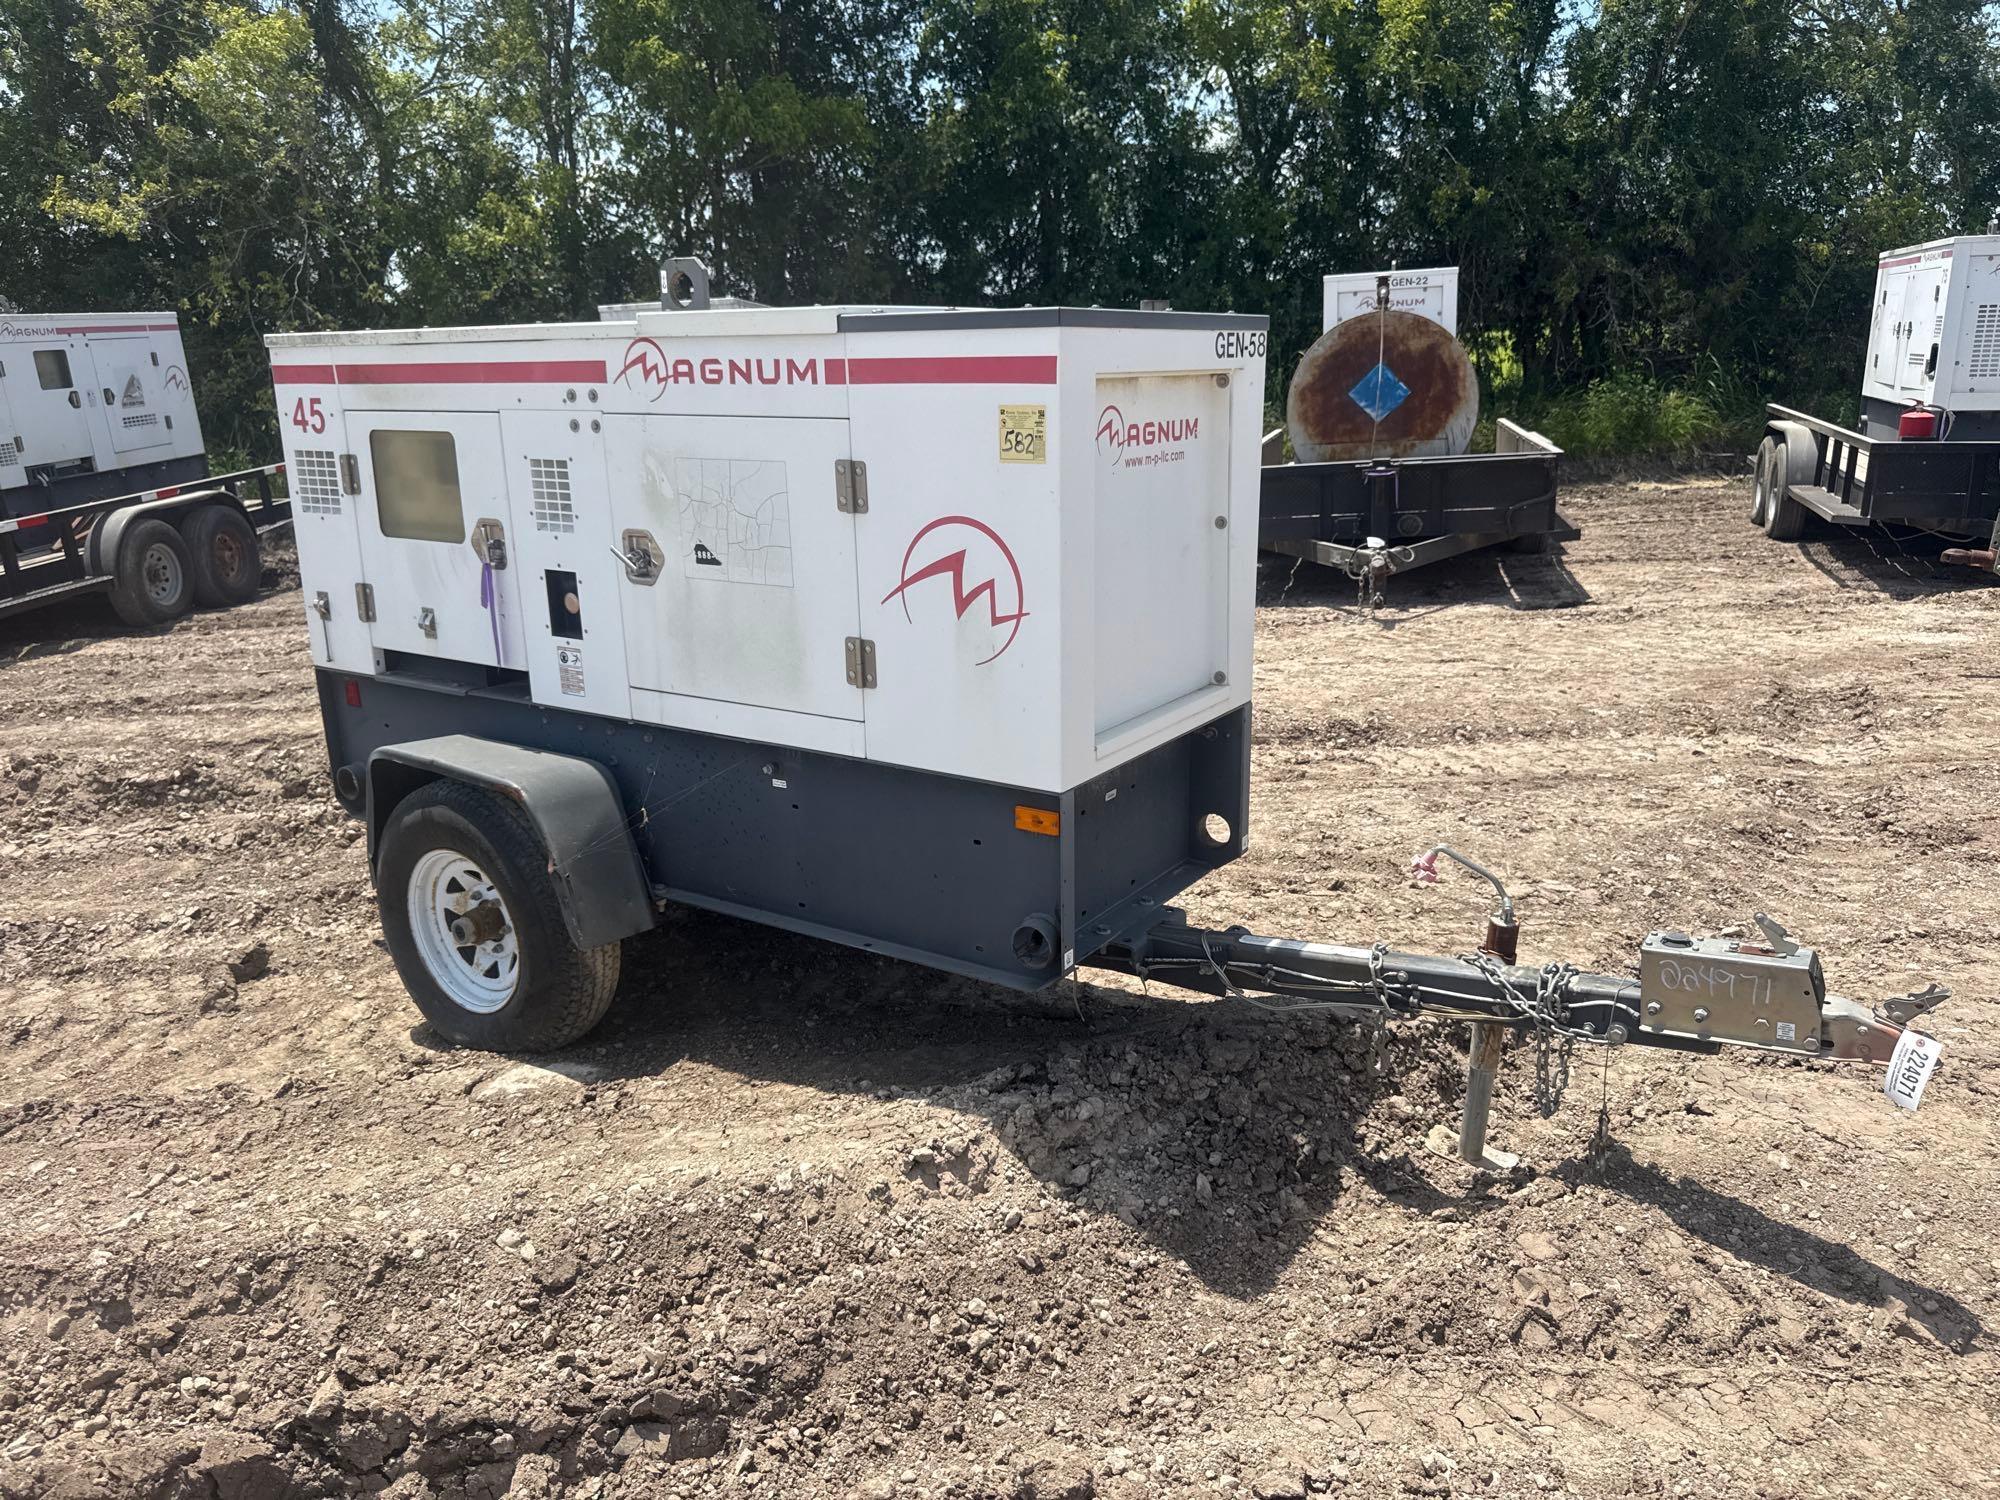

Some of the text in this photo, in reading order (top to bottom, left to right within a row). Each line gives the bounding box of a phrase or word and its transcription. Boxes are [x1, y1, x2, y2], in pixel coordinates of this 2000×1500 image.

[1392, 277, 1428, 287] GEN-22
[1215, 331, 1266, 359] GEN-58
[614, 337, 819, 402] MAGNUM
[293, 397, 326, 434] 45
[1095, 405, 1199, 466] MAGNUM
[1002, 429, 1035, 455] 582
[1658, 959, 1772, 1006] 224971
[1897, 1048, 1930, 1099] 224971
